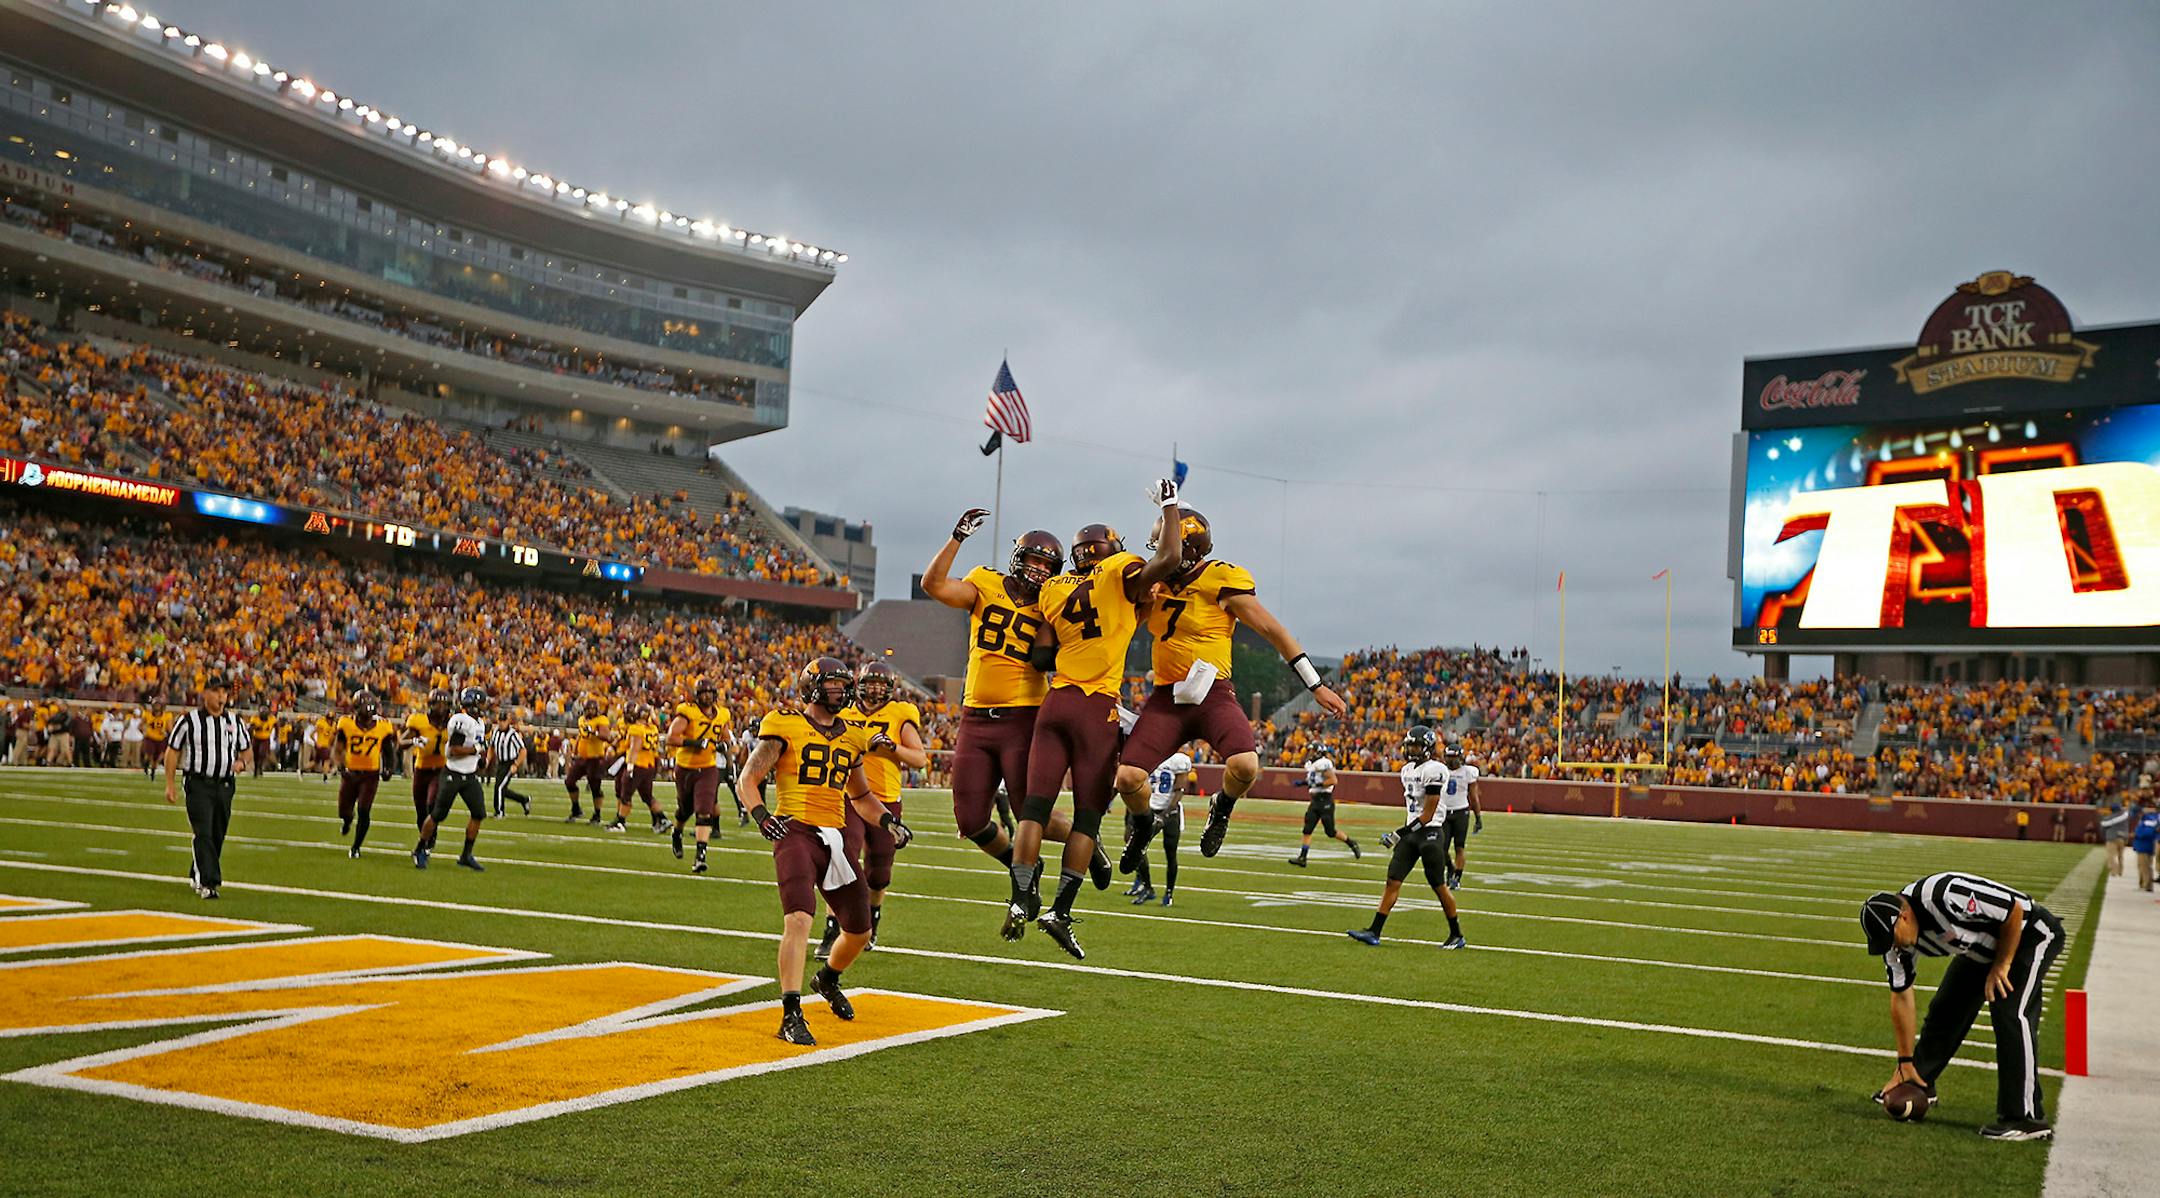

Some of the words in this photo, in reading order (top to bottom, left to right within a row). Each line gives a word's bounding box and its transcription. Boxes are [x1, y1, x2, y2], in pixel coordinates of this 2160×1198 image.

[1965, 299, 2026, 330] TCF
[1951, 322, 2036, 354] BANK
[1760, 369, 1867, 411] Coca-Cola
[1926, 351, 2060, 387] STADIUM
[384, 523, 412, 547] TD
[512, 545, 539, 567] TD
[1774, 462, 2160, 628] TD
[1061, 579, 1102, 641] 4
[1161, 598, 1186, 642] 7
[977, 603, 1043, 663] 85
[350, 736, 378, 756] 27
[431, 734, 441, 755] 1
[698, 722, 721, 744] 79
[798, 743, 851, 791] 88
